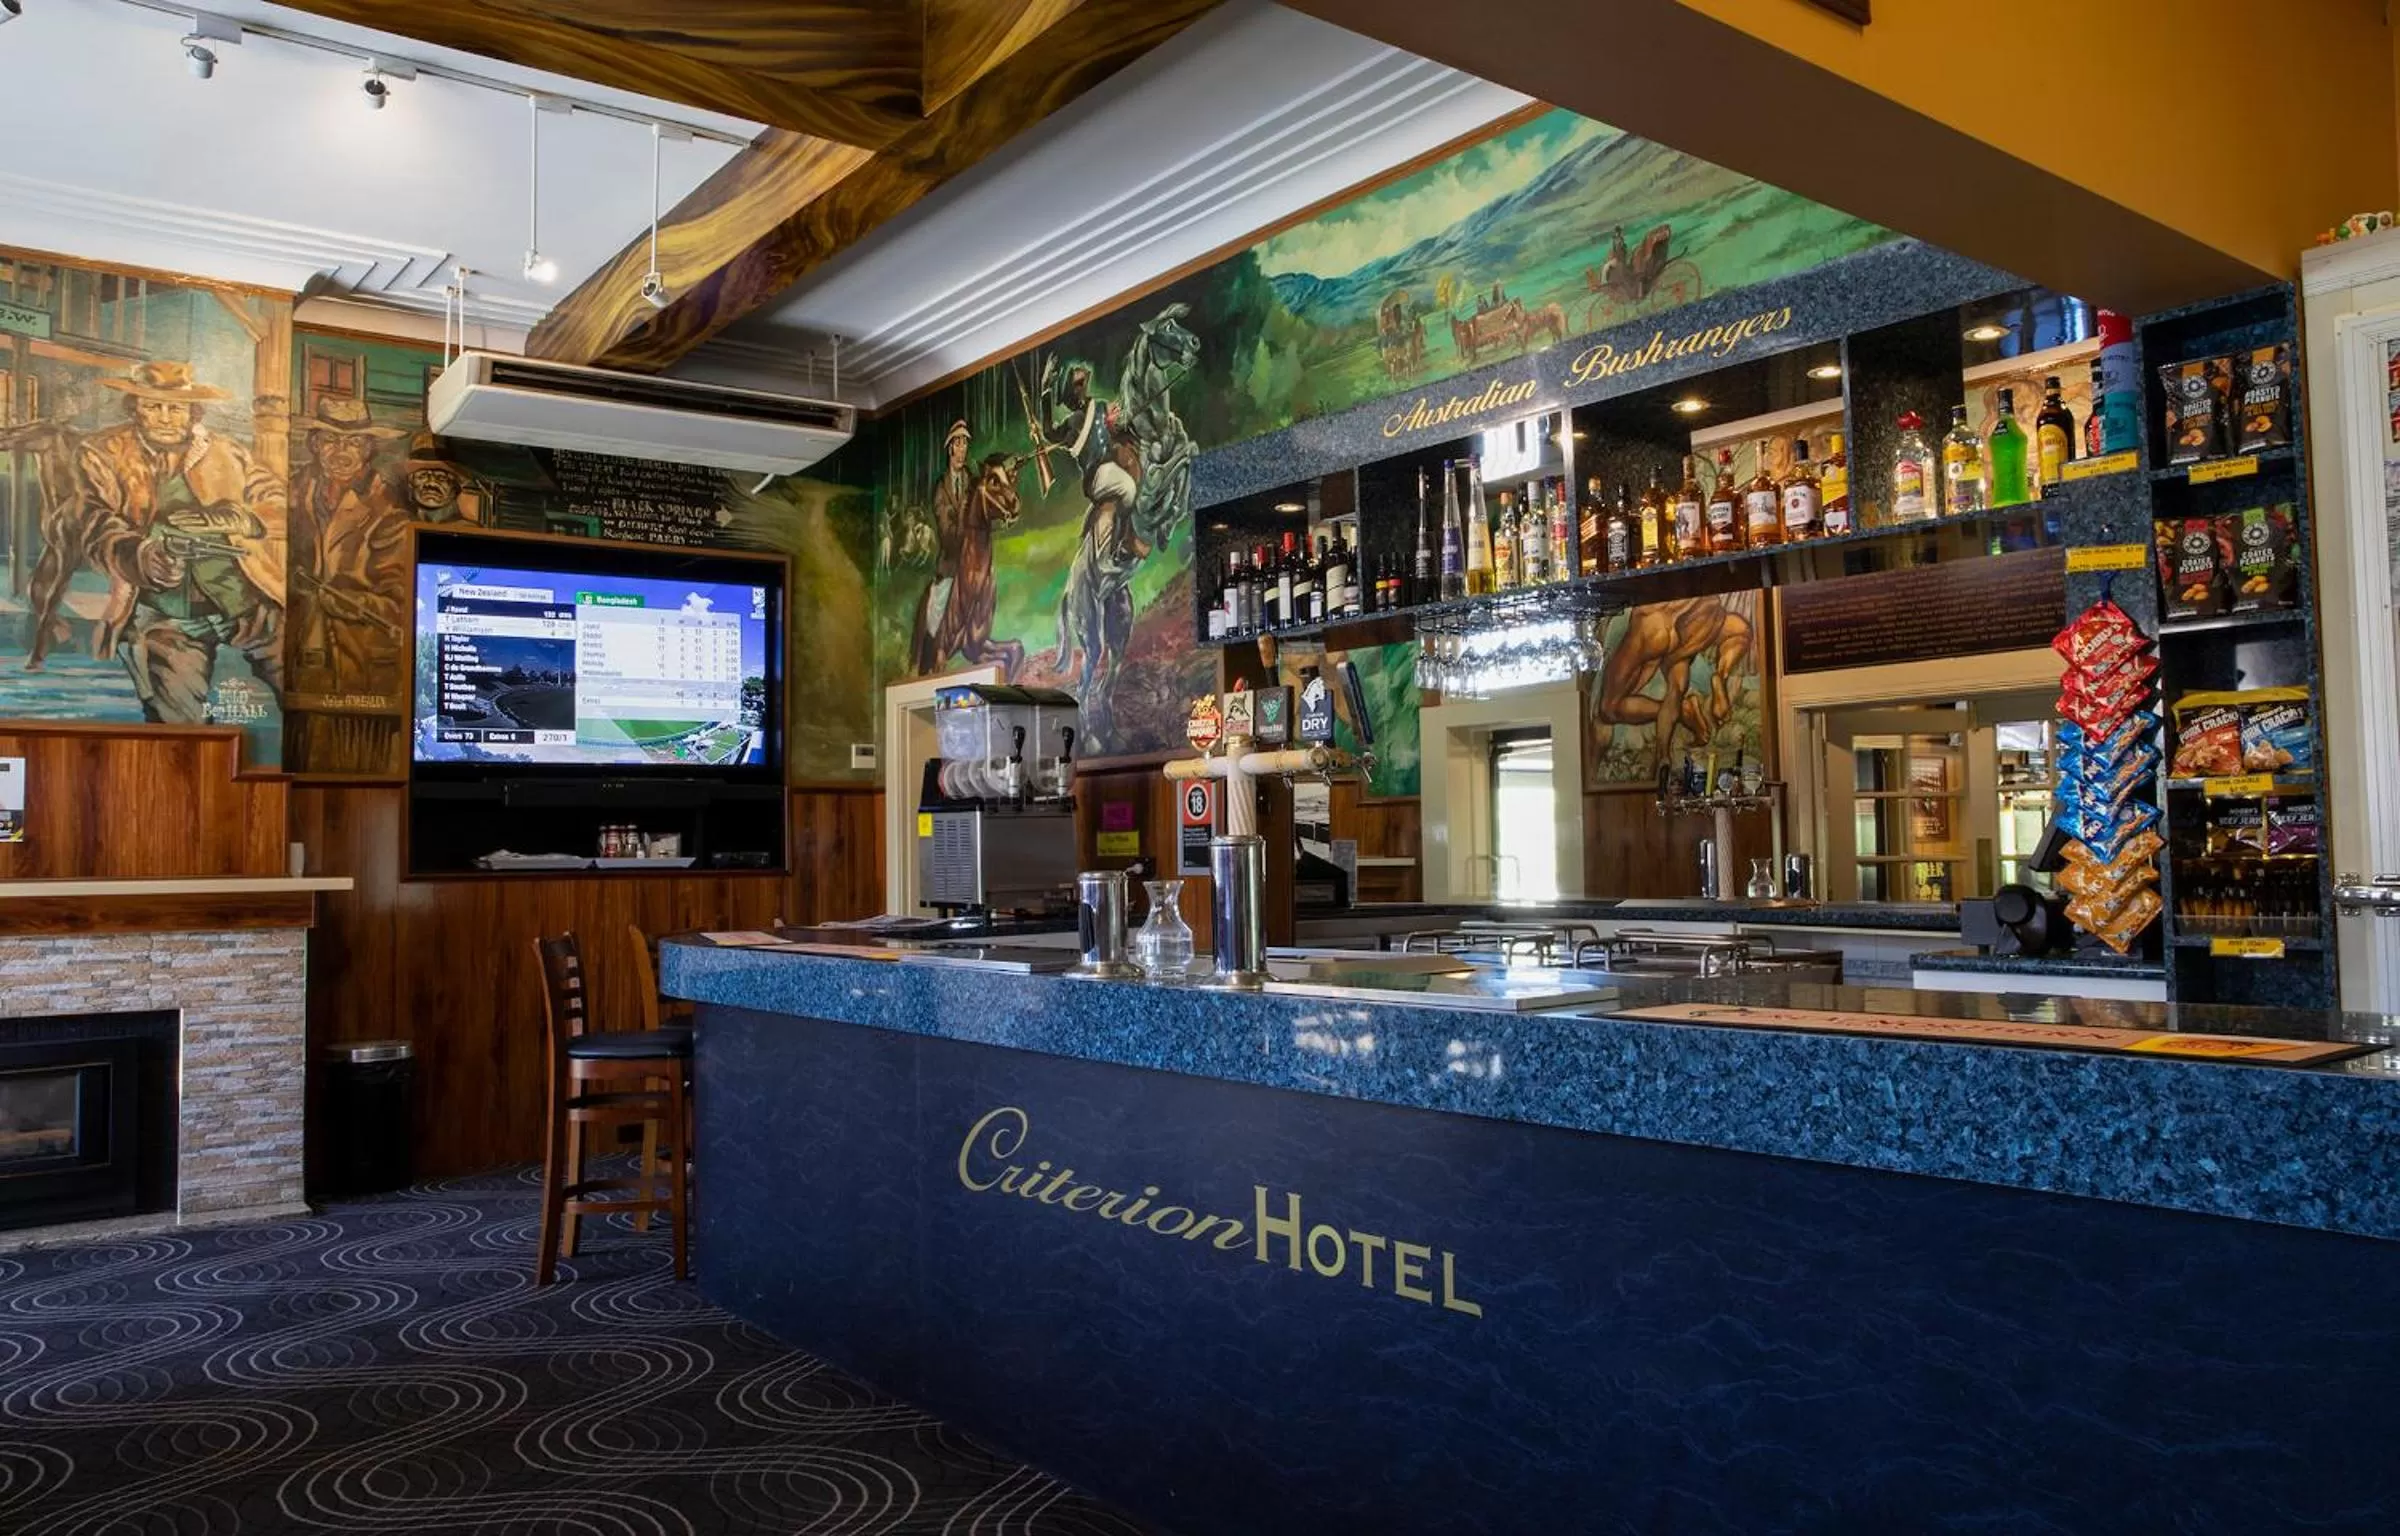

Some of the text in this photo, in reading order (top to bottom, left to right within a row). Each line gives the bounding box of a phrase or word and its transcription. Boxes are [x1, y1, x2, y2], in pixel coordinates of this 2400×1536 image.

[1383, 307, 1792, 438] Australian Bushrangers
[459, 588, 476, 597] New
[477, 589, 507, 598] Zealand
[1302, 717, 1329, 731] DRY
[1191, 796, 1204, 814] 18
[958, 1107, 1483, 1320] Criterion HOTEL
